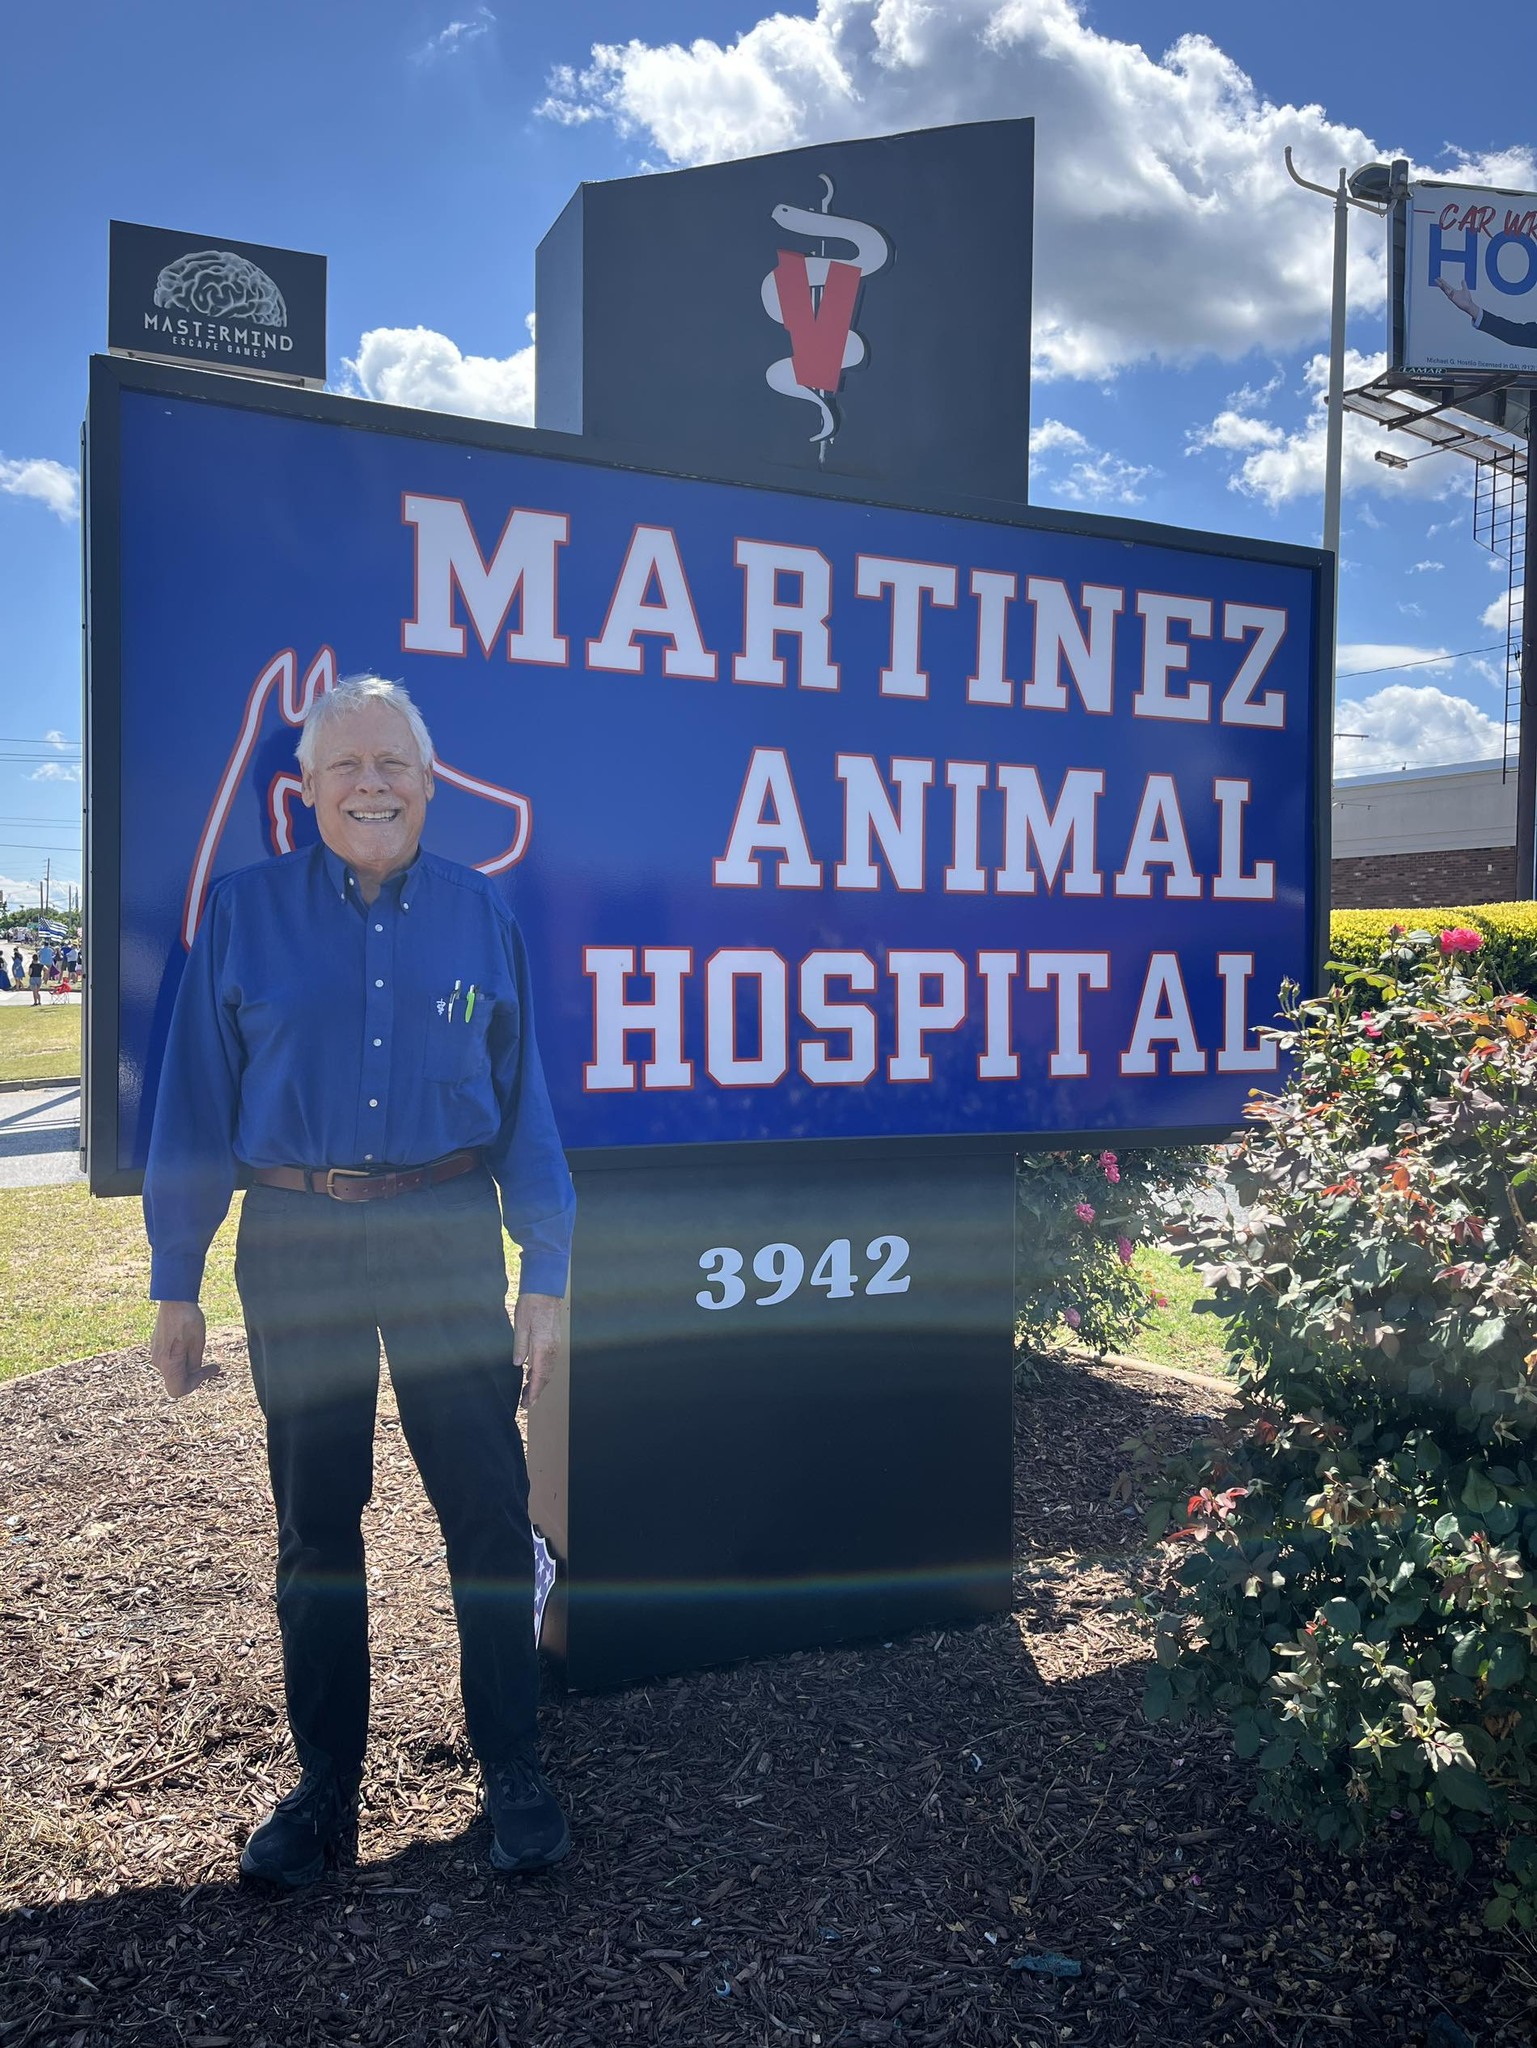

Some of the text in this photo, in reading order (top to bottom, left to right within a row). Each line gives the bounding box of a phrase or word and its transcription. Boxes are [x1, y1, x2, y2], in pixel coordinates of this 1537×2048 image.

[1438, 203, 1497, 238] CAR
[1428, 224, 1537, 296] HO
[144, 312, 294, 351] MASTERMIND
[172, 336, 267, 359] ESCAPE GAMES
[1426, 357, 1449, 365] Michael
[1477, 360, 1502, 369] licensed
[400, 491, 1288, 730] MARTINEZ
[712, 745, 1275, 901] ANIMAL
[582, 945, 1279, 1092] HOSPITAL
[695, 1235, 911, 1310] 3942
